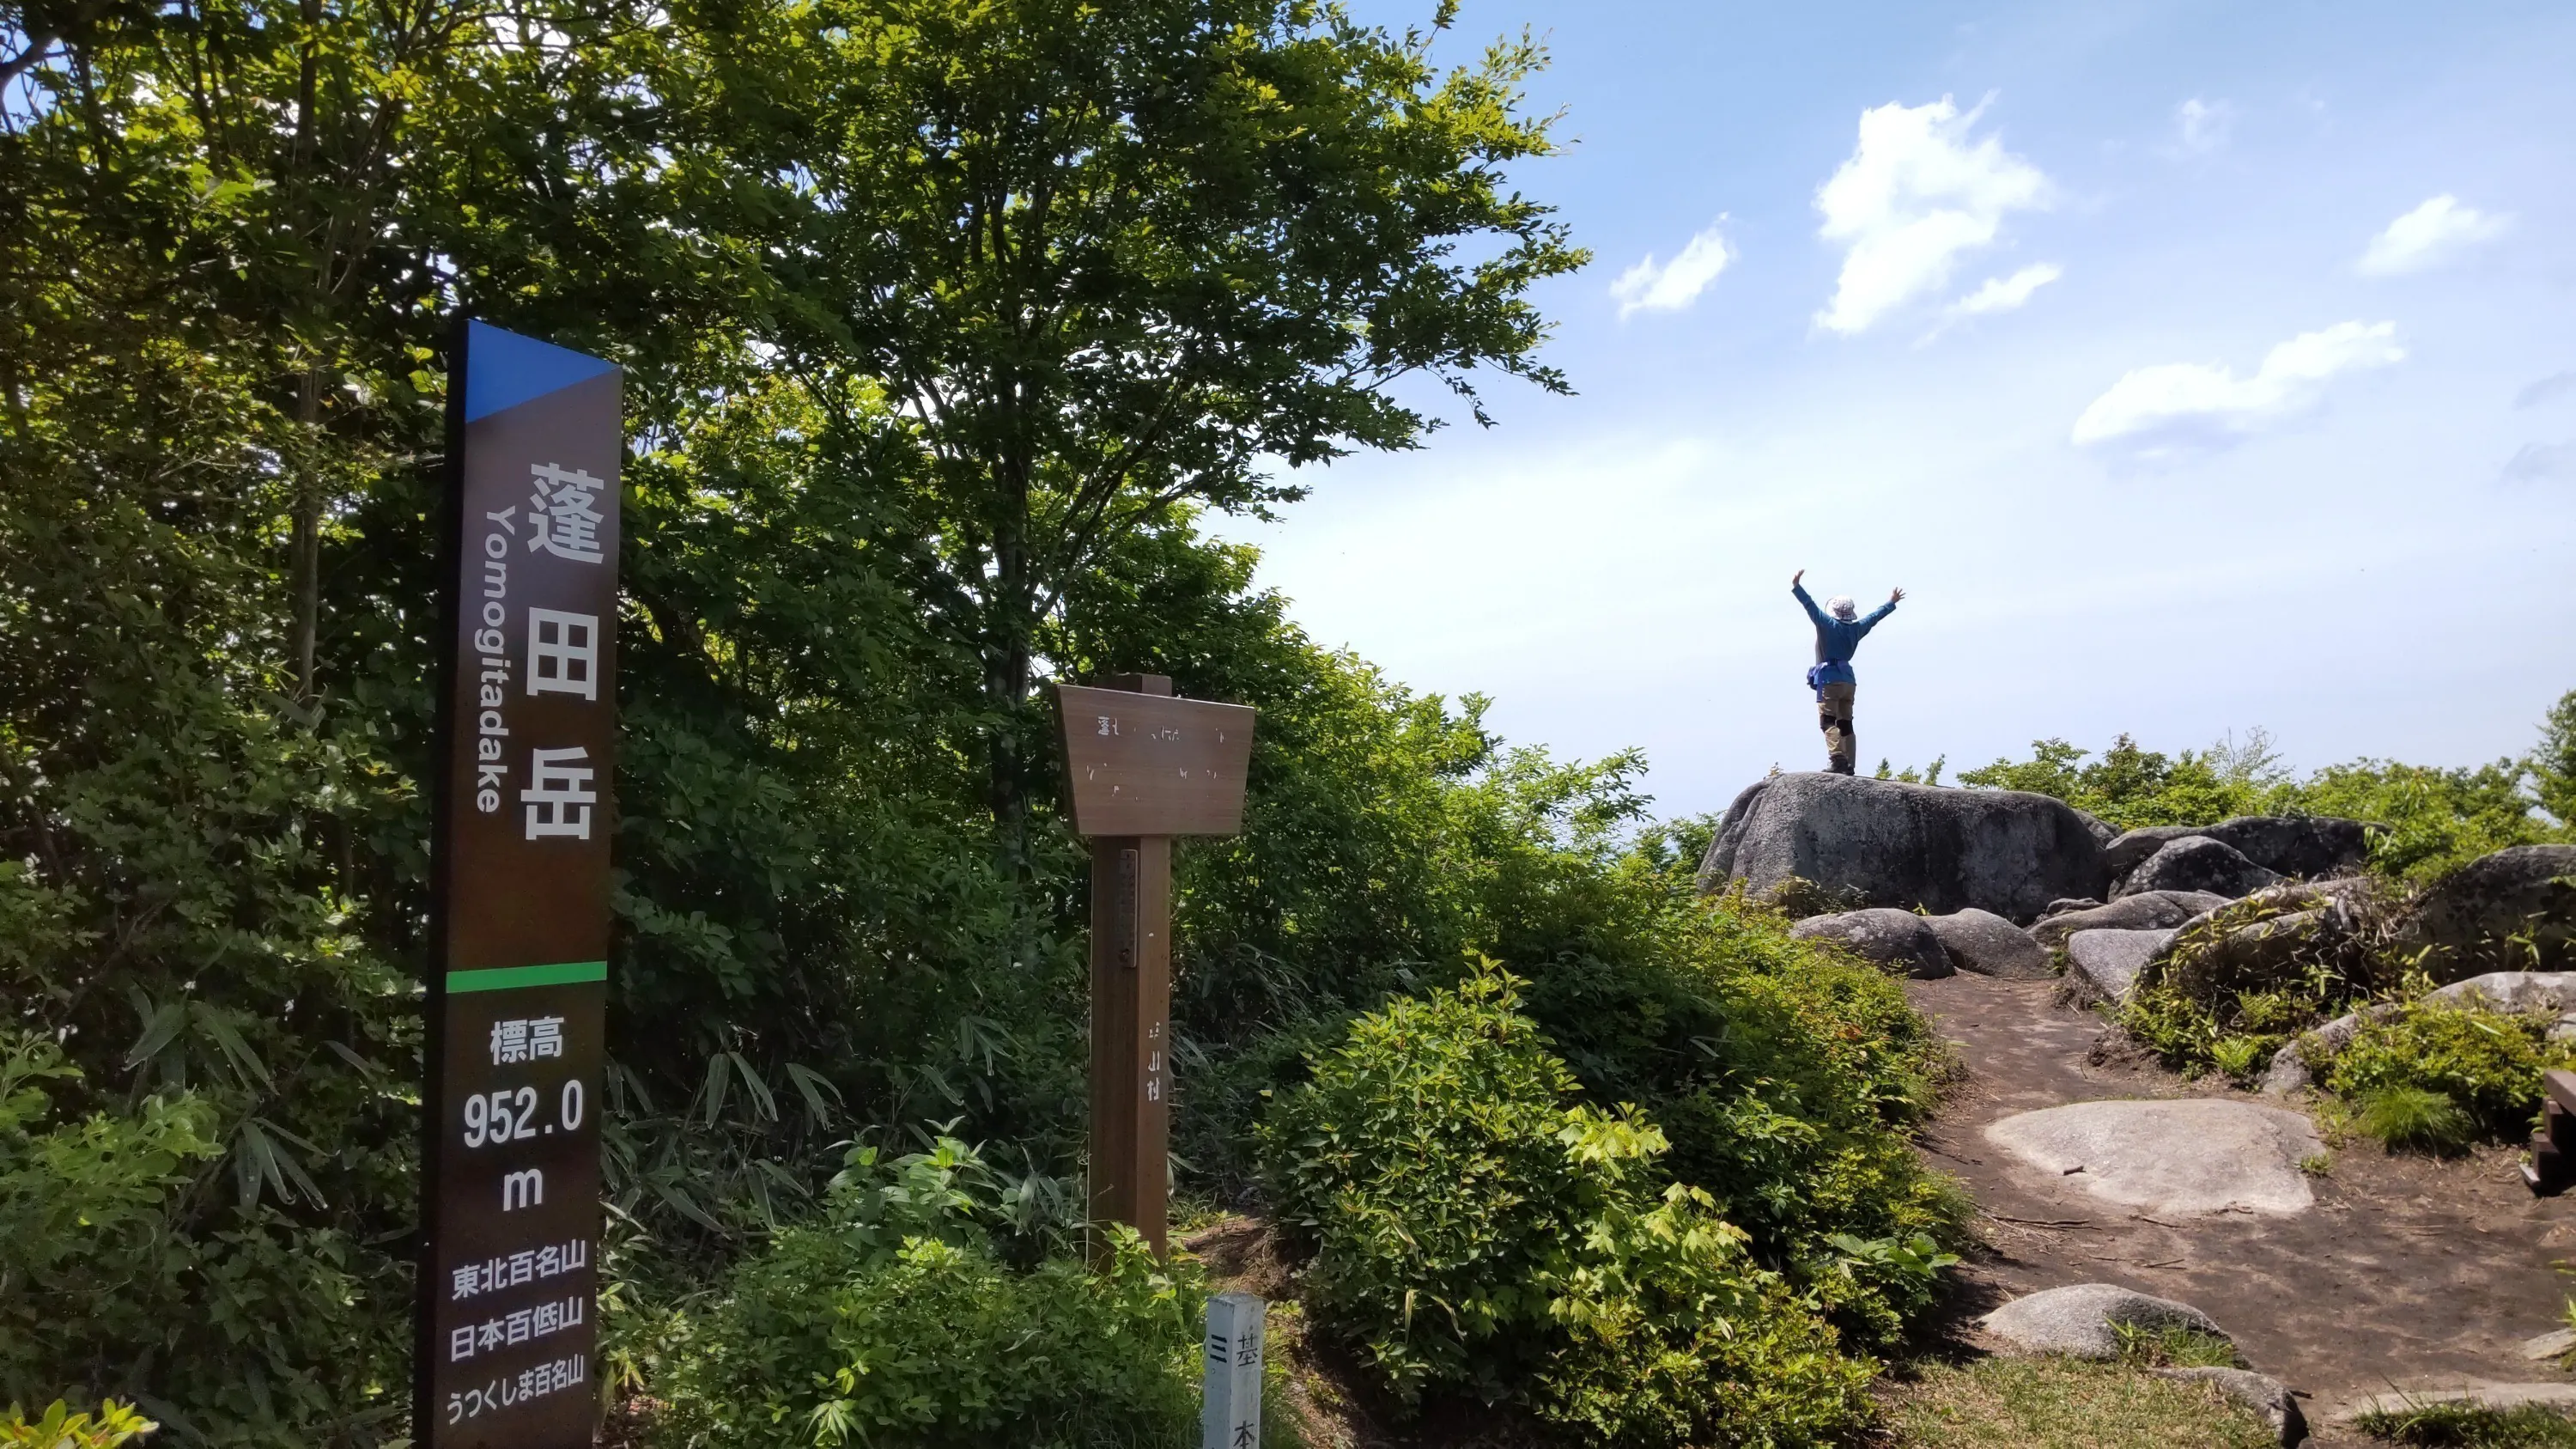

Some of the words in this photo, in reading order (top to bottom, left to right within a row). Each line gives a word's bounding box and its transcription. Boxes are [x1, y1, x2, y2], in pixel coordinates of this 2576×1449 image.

[475, 505, 515, 813] Yomogitadake
[520, 463, 605, 840] 蓬田岳
[490, 1016, 564, 1065] 標高
[465, 1080, 583, 1148] 952.0
[503, 1168, 543, 1212] m
[453, 1239, 586, 1301] 東北百名山
[452, 1296, 583, 1363] 日本百低山
[447, 1354, 584, 1426] うつくしま百名山
